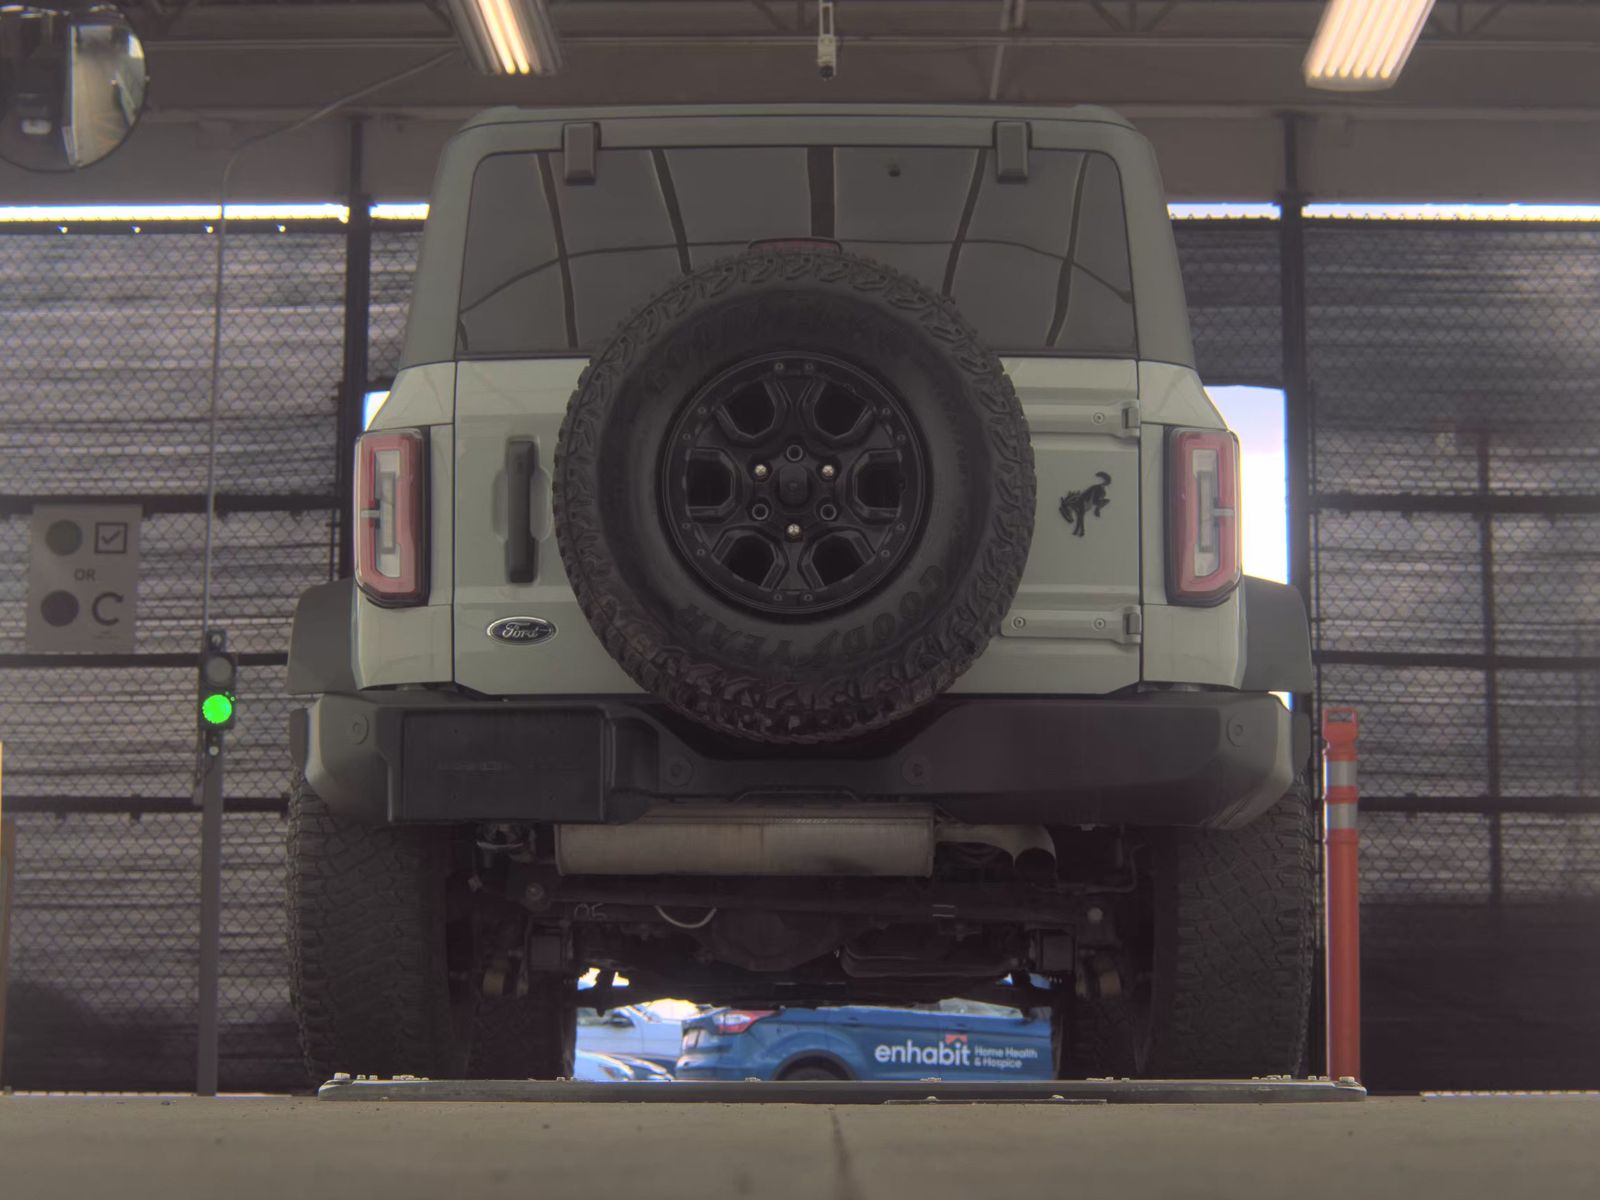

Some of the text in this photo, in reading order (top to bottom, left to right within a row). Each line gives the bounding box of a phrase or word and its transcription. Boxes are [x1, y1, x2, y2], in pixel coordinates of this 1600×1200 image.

[73, 567, 97, 583] OR
[502, 621, 540, 639] Ford
[874, 1039, 970, 1067] enhabit
[974, 1045, 1038, 1060] Home Health
[983, 1057, 1023, 1070] Hospice
